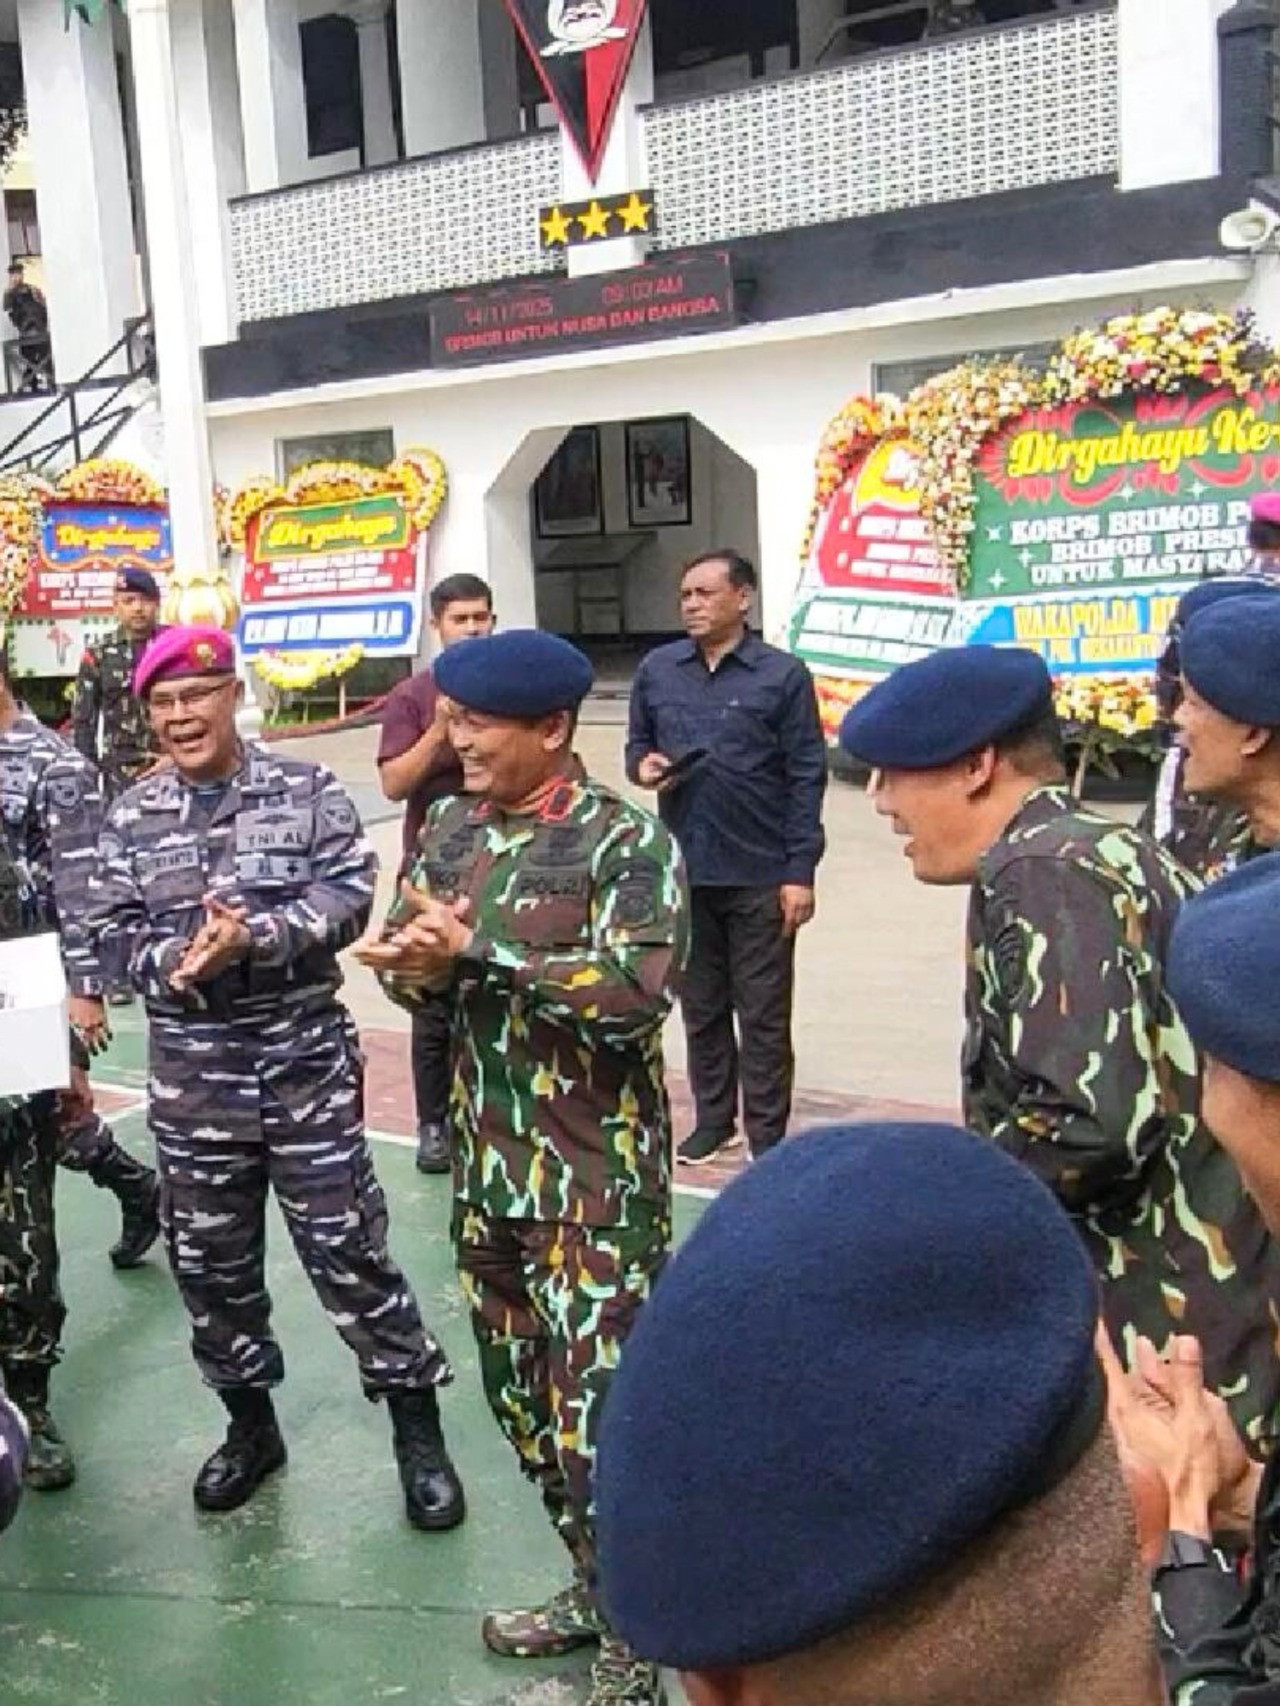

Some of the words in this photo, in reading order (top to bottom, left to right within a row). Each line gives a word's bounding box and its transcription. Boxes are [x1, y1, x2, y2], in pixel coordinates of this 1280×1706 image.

[562, 314, 607, 336] NUSA
[609, 308, 644, 328] DAN
[647, 297, 719, 323] BANGSA
[1007, 420, 1211, 484] Dirgahayu
[268, 513, 397, 550] Dirgahayu
[1010, 514, 1100, 545] KORPS
[1108, 503, 1220, 536] BRIMOB
[1226, 500, 1252, 527] P
[1051, 535, 1152, 563] BRIMOB
[1031, 560, 1115, 585] UNTUK
[1013, 597, 1139, 640] WAKAPOLDA
[245, 832, 276, 848] TNI
[283, 830, 307, 845] AL
